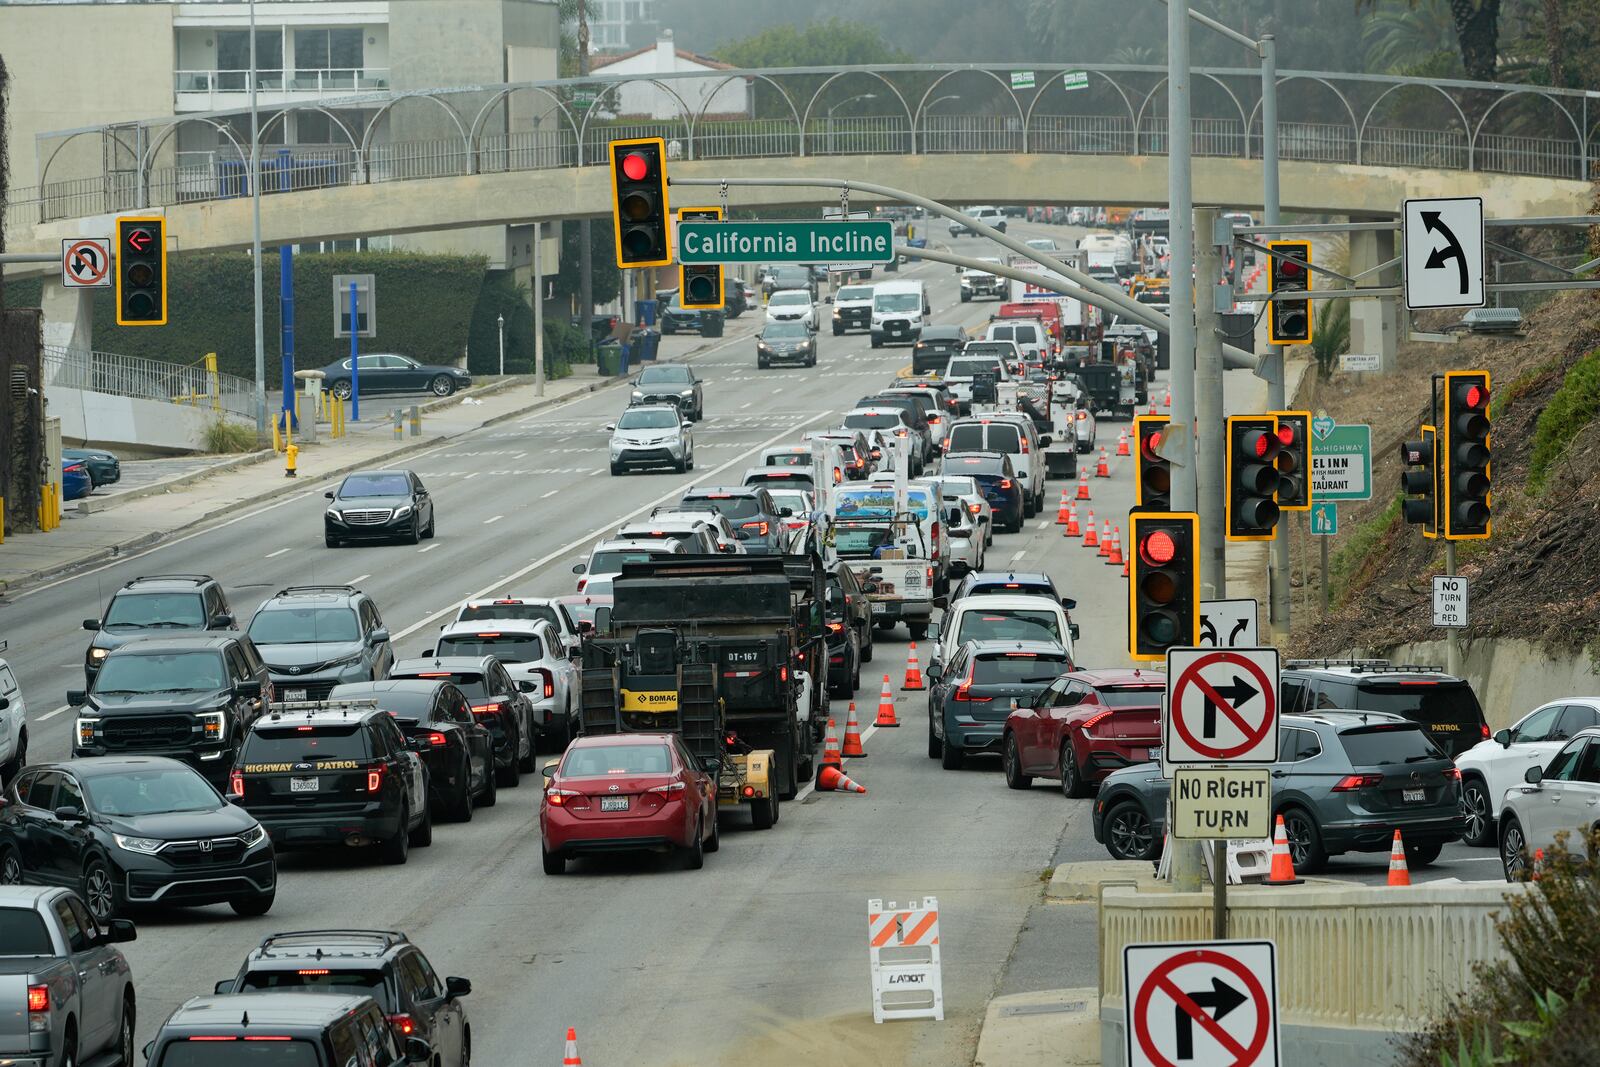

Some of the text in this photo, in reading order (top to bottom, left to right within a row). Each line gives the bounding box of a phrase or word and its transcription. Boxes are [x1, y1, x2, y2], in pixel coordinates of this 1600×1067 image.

[684, 230, 887, 254] California Incline
[1313, 457, 1349, 468] EL INN
[1312, 481, 1348, 489] TAURANT
[1442, 581, 1459, 591] NO
[1440, 593, 1461, 602] TURN
[1444, 603, 1456, 612] ON
[1441, 613, 1458, 622] RED
[728, 652, 758, 661] DT-167
[649, 694, 677, 702] BOMAG
[1431, 724, 1461, 732] PATROL
[245, 763, 293, 773] HIGHWAY
[316, 760, 359, 770] PATROL
[1180, 778, 1267, 800] NO RIGHT
[1194, 810, 1249, 828] TURN
[888, 973, 926, 984] LADOT
